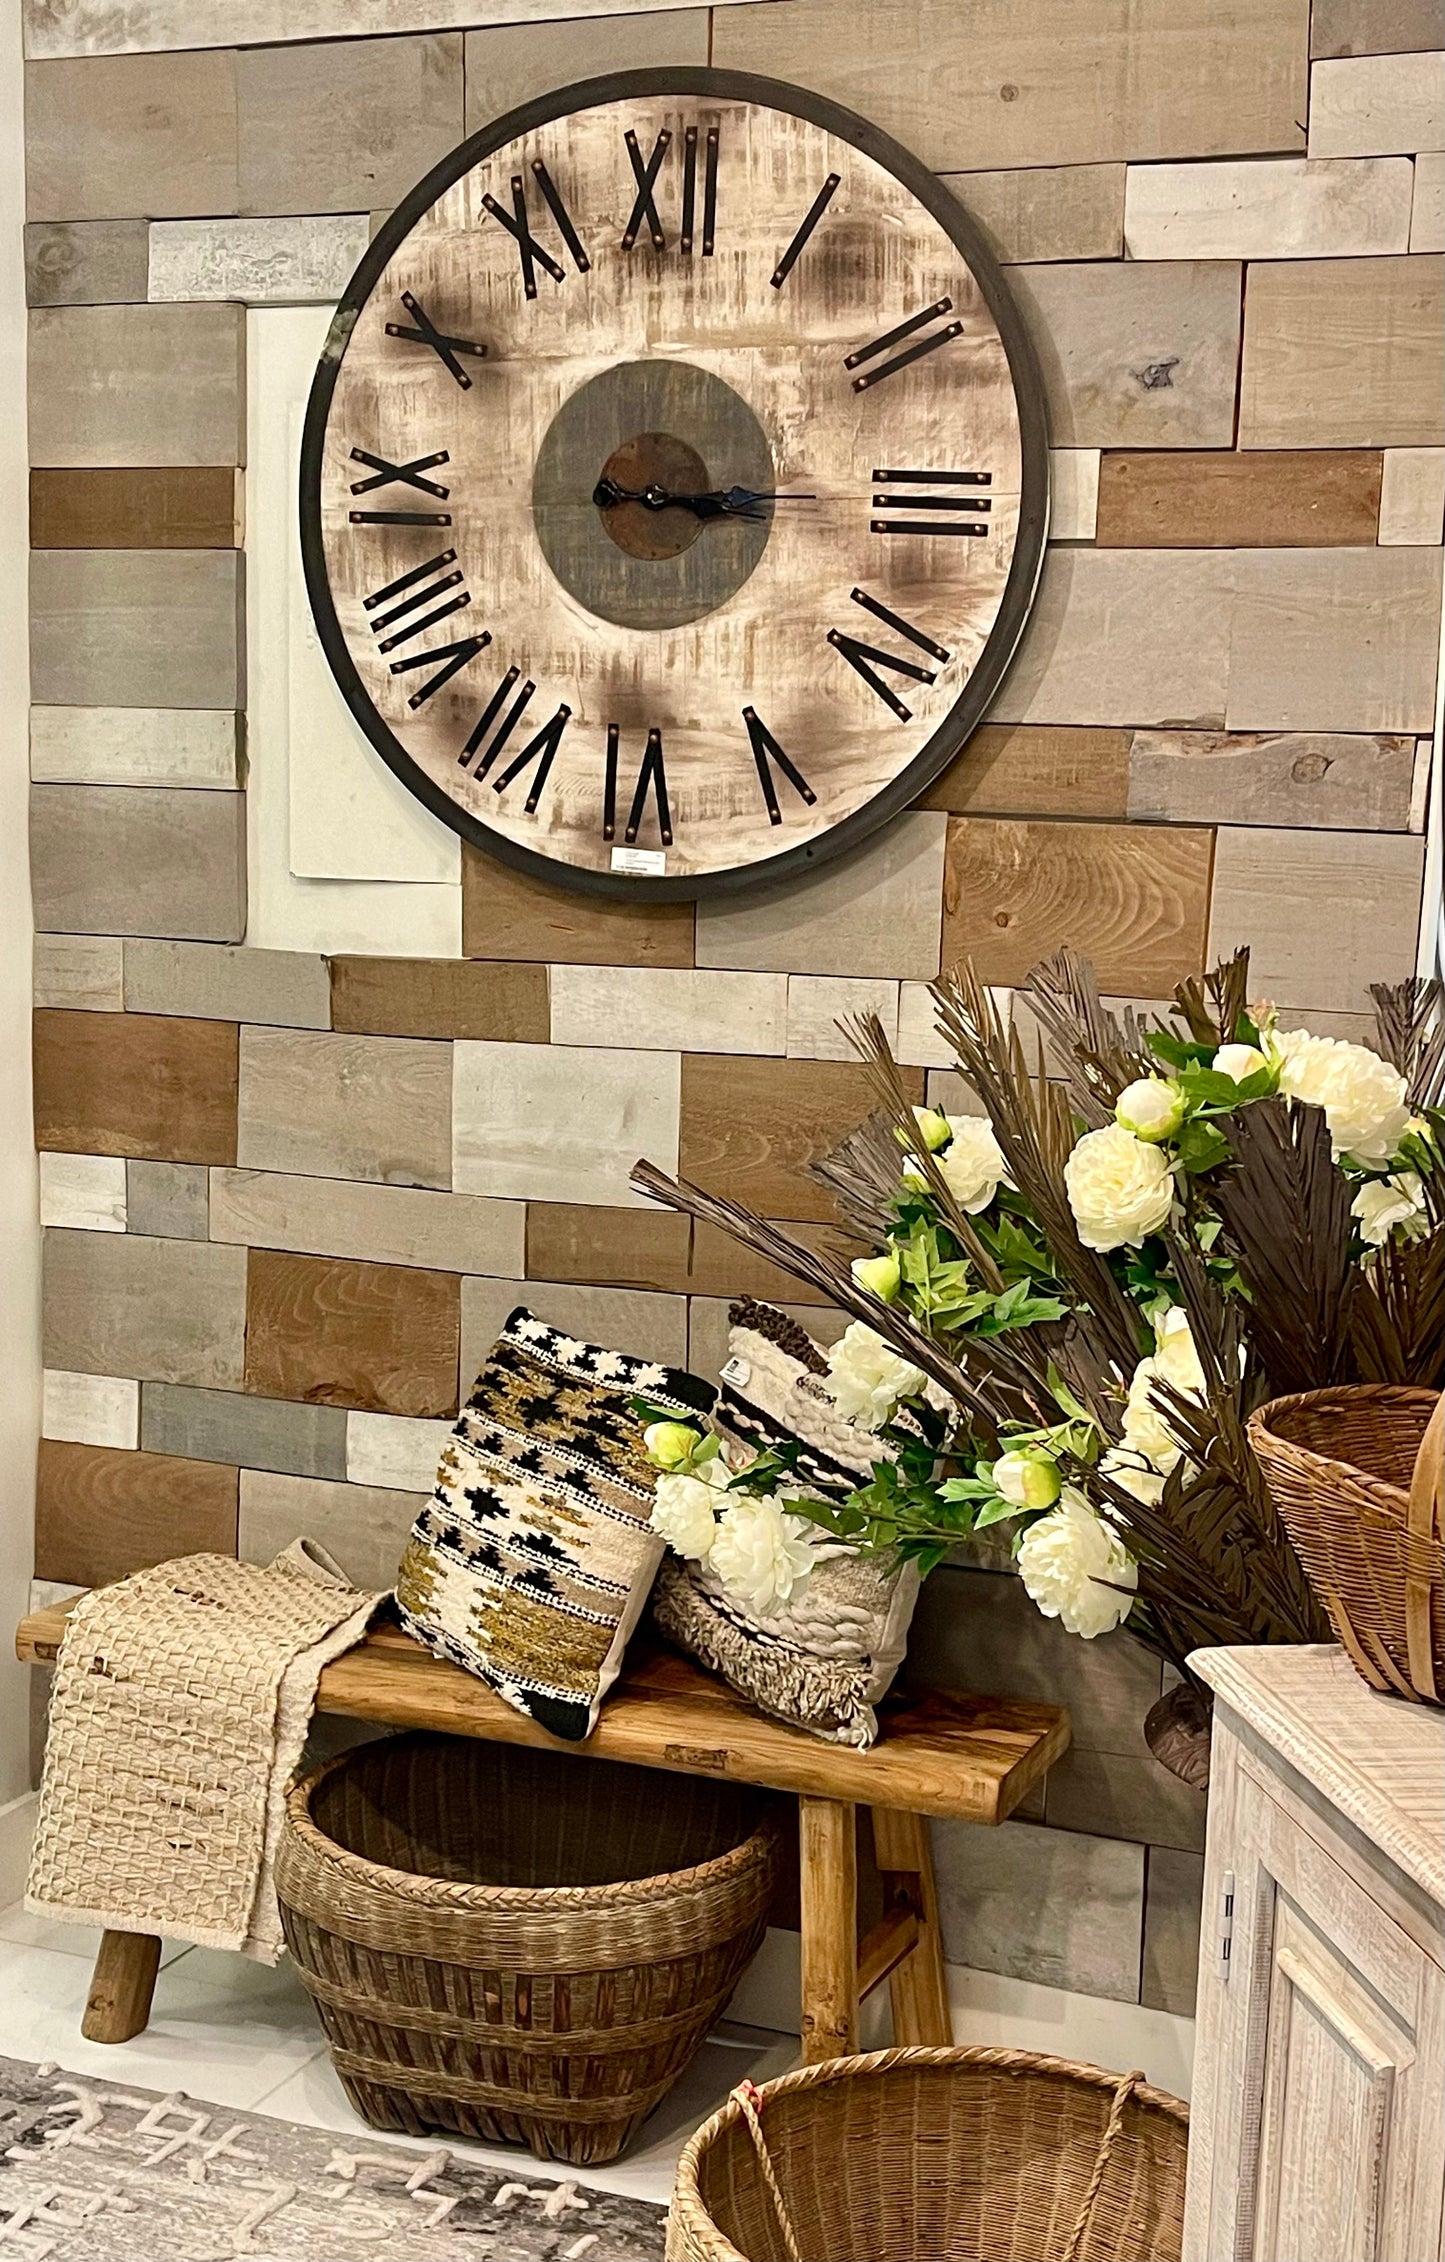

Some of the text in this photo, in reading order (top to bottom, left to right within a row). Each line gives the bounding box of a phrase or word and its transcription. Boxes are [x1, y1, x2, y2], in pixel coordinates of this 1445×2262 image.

[481, 158, 591, 301] XI
[620, 126, 720, 257] XII
[769, 172, 842, 290] I
[384, 290, 489, 391] X
[843, 297, 964, 394] II
[349, 447, 452, 527] IX
[870, 469, 992, 537] III
[826, 587, 951, 724] IV
[457, 665, 572, 815] VII
[602, 722, 673, 847] VI
[741, 705, 817, 826] V
